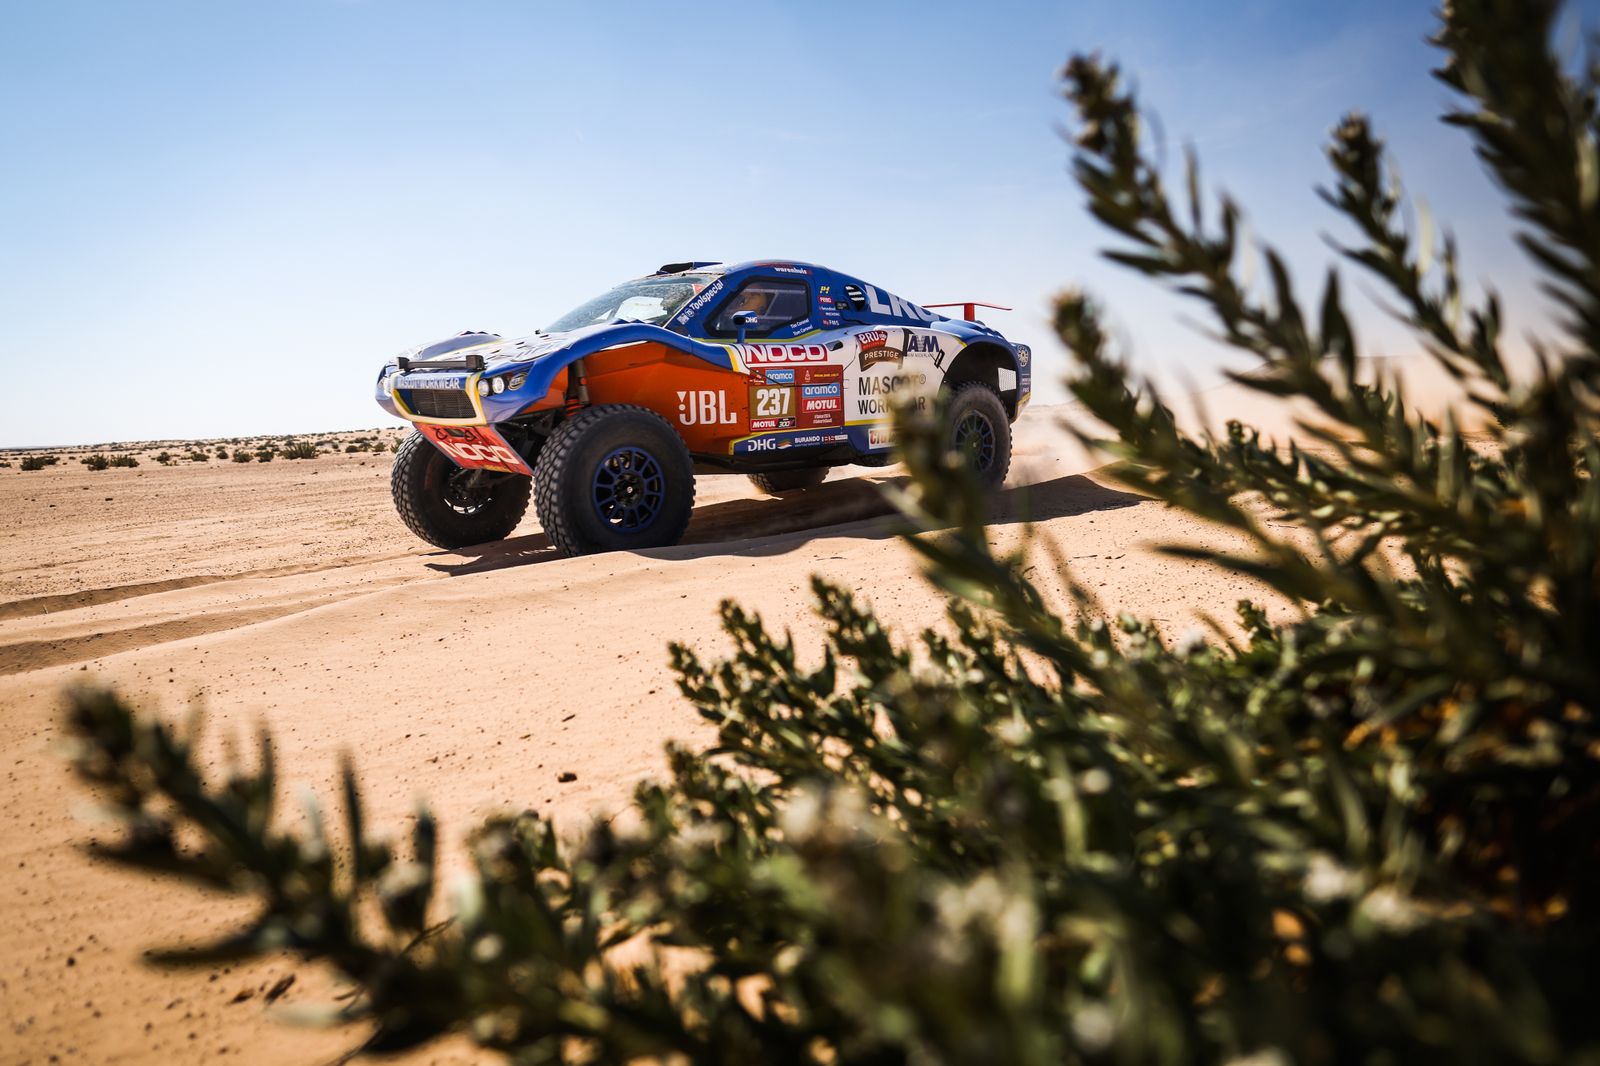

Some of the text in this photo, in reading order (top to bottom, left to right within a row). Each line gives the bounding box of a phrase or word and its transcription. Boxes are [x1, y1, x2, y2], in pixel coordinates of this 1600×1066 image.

[689, 280, 724, 310] Toolspecial
[747, 344, 826, 362] NOCO
[864, 350, 899, 360] PRESTIGE
[767, 372, 793, 380] aramco
[804, 385, 838, 395] aramco
[677, 390, 737, 425] JBL
[756, 388, 790, 416] 237
[806, 399, 837, 410] MOTUL
[437, 440, 520, 465] NOCO
[747, 438, 776, 452] DHG
